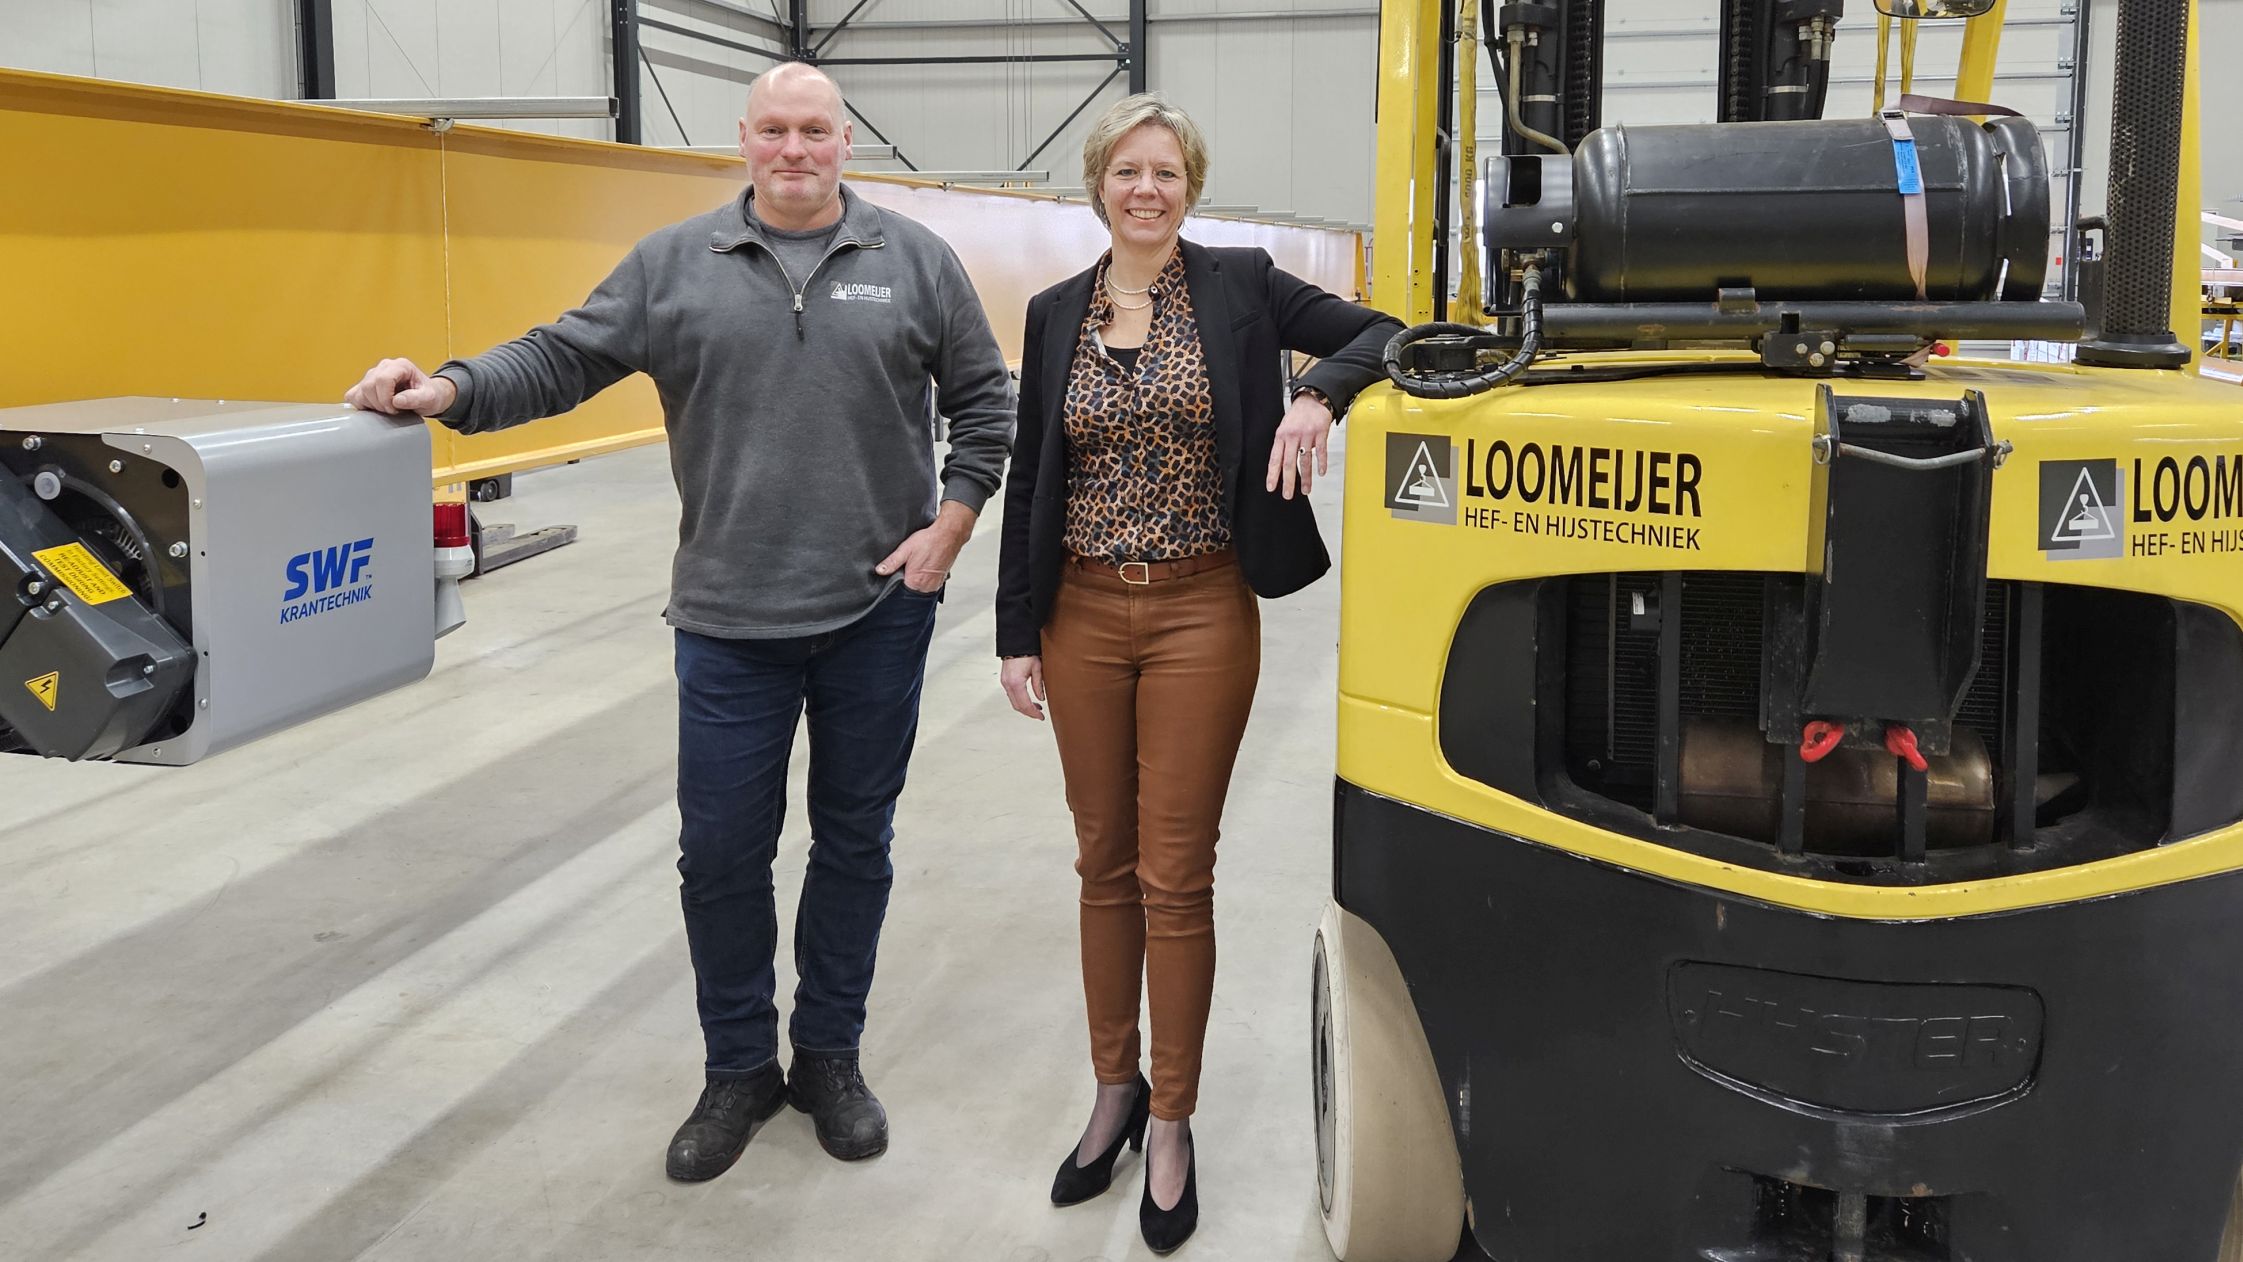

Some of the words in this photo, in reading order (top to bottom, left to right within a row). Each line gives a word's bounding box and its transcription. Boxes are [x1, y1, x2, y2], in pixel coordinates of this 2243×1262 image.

[847, 283, 891, 298] LOOMEIJER
[1466, 438, 1702, 517] LOOMEIJER
[1465, 506, 1508, 530] HEF-
[1514, 511, 1540, 534] EN
[1546, 515, 1701, 551] HIJSTECHNIEK
[2132, 533, 2175, 557] HEF-
[2181, 531, 2206, 554] EN
[55, 558, 70, 571] TEST
[283, 537, 374, 602] SWF
[92, 582, 106, 594] AND
[280, 584, 373, 625] KRANTECHNIK
